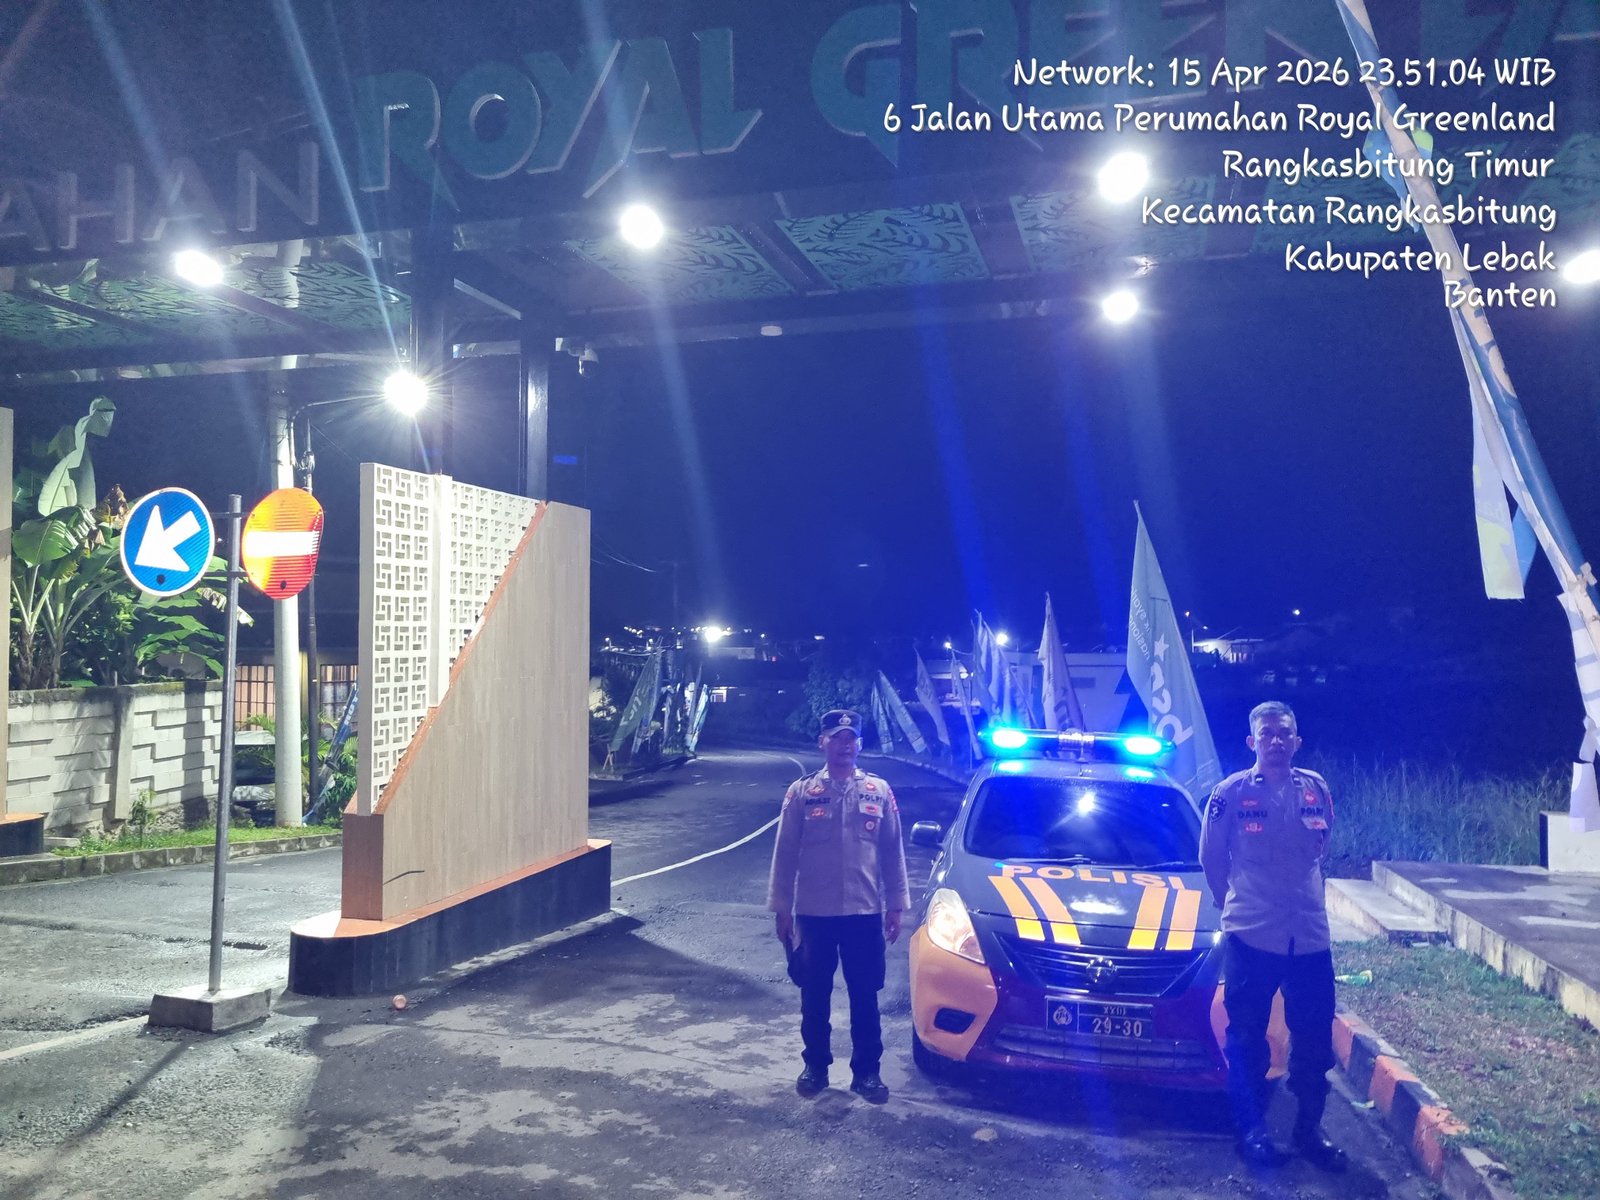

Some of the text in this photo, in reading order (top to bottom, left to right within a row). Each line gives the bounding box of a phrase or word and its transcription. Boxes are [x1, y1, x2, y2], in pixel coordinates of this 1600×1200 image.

[354, 27, 764, 212] ROYAL
[1001, 864, 1186, 891] POLISI
[1091, 1016, 1143, 1038] 29-30
